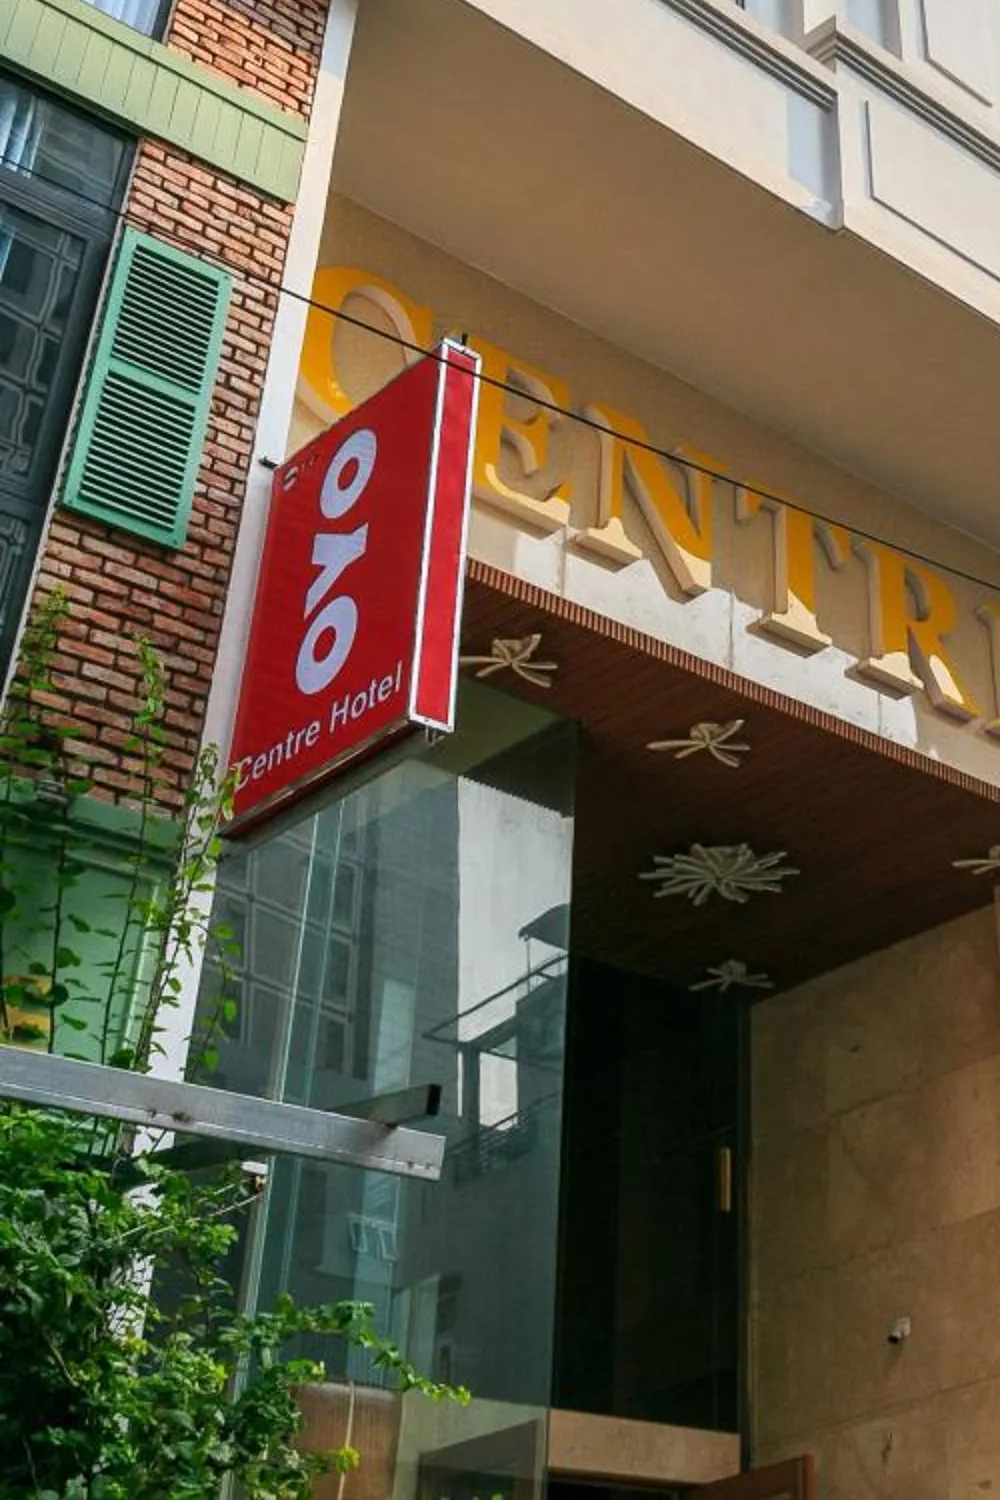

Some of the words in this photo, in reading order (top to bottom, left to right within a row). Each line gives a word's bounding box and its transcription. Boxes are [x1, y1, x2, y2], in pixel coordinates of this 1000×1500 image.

[295, 428, 377, 695] OYO
[234, 720, 321, 792] Centre
[329, 659, 402, 734] Hotel
